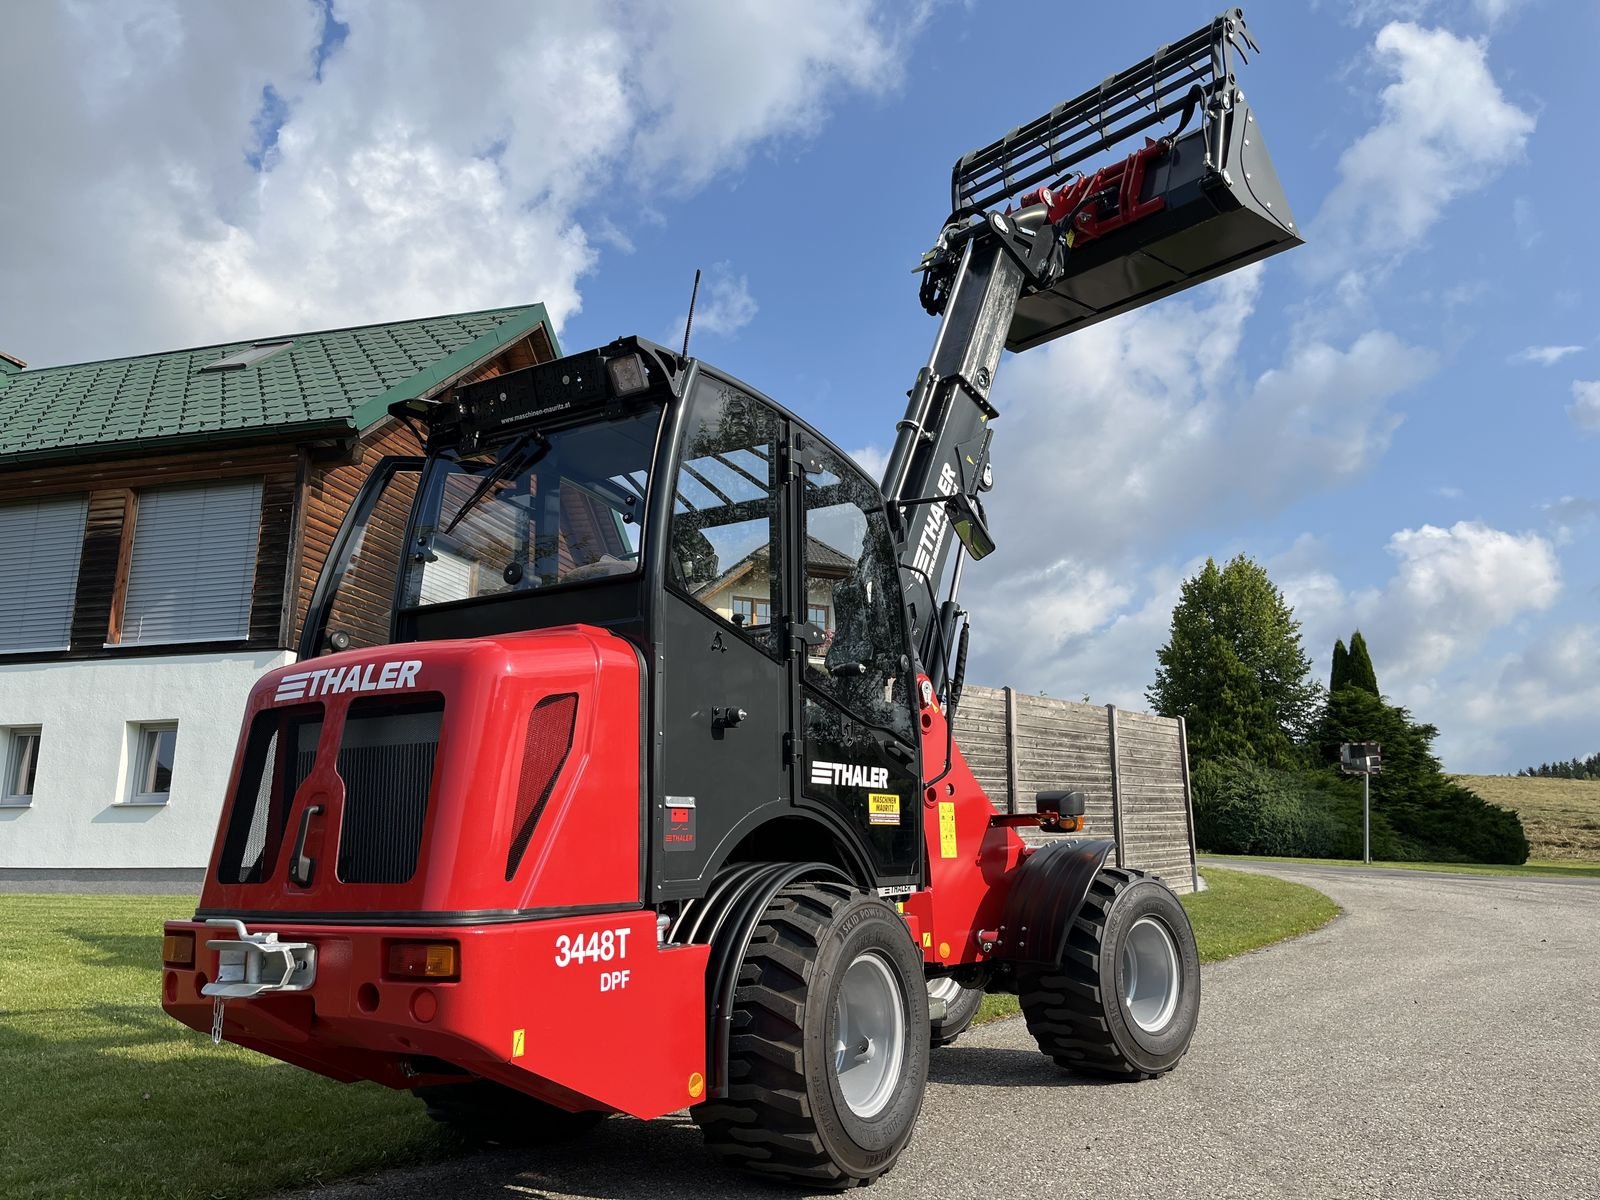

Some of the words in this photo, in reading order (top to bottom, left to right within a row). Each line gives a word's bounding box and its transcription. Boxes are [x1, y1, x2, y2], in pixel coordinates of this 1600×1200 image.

[501, 401, 571, 424] www.maschinen-mauritz.at
[308, 660, 422, 697] THALER
[832, 762, 889, 789] THALER
[872, 795, 897, 804] MASCHINEN
[875, 804, 895, 812] MAURITZ
[672, 834, 694, 842] THALER
[842, 914, 860, 933] SKID
[554, 927, 631, 968] 3448T
[600, 969, 631, 992] DPF
